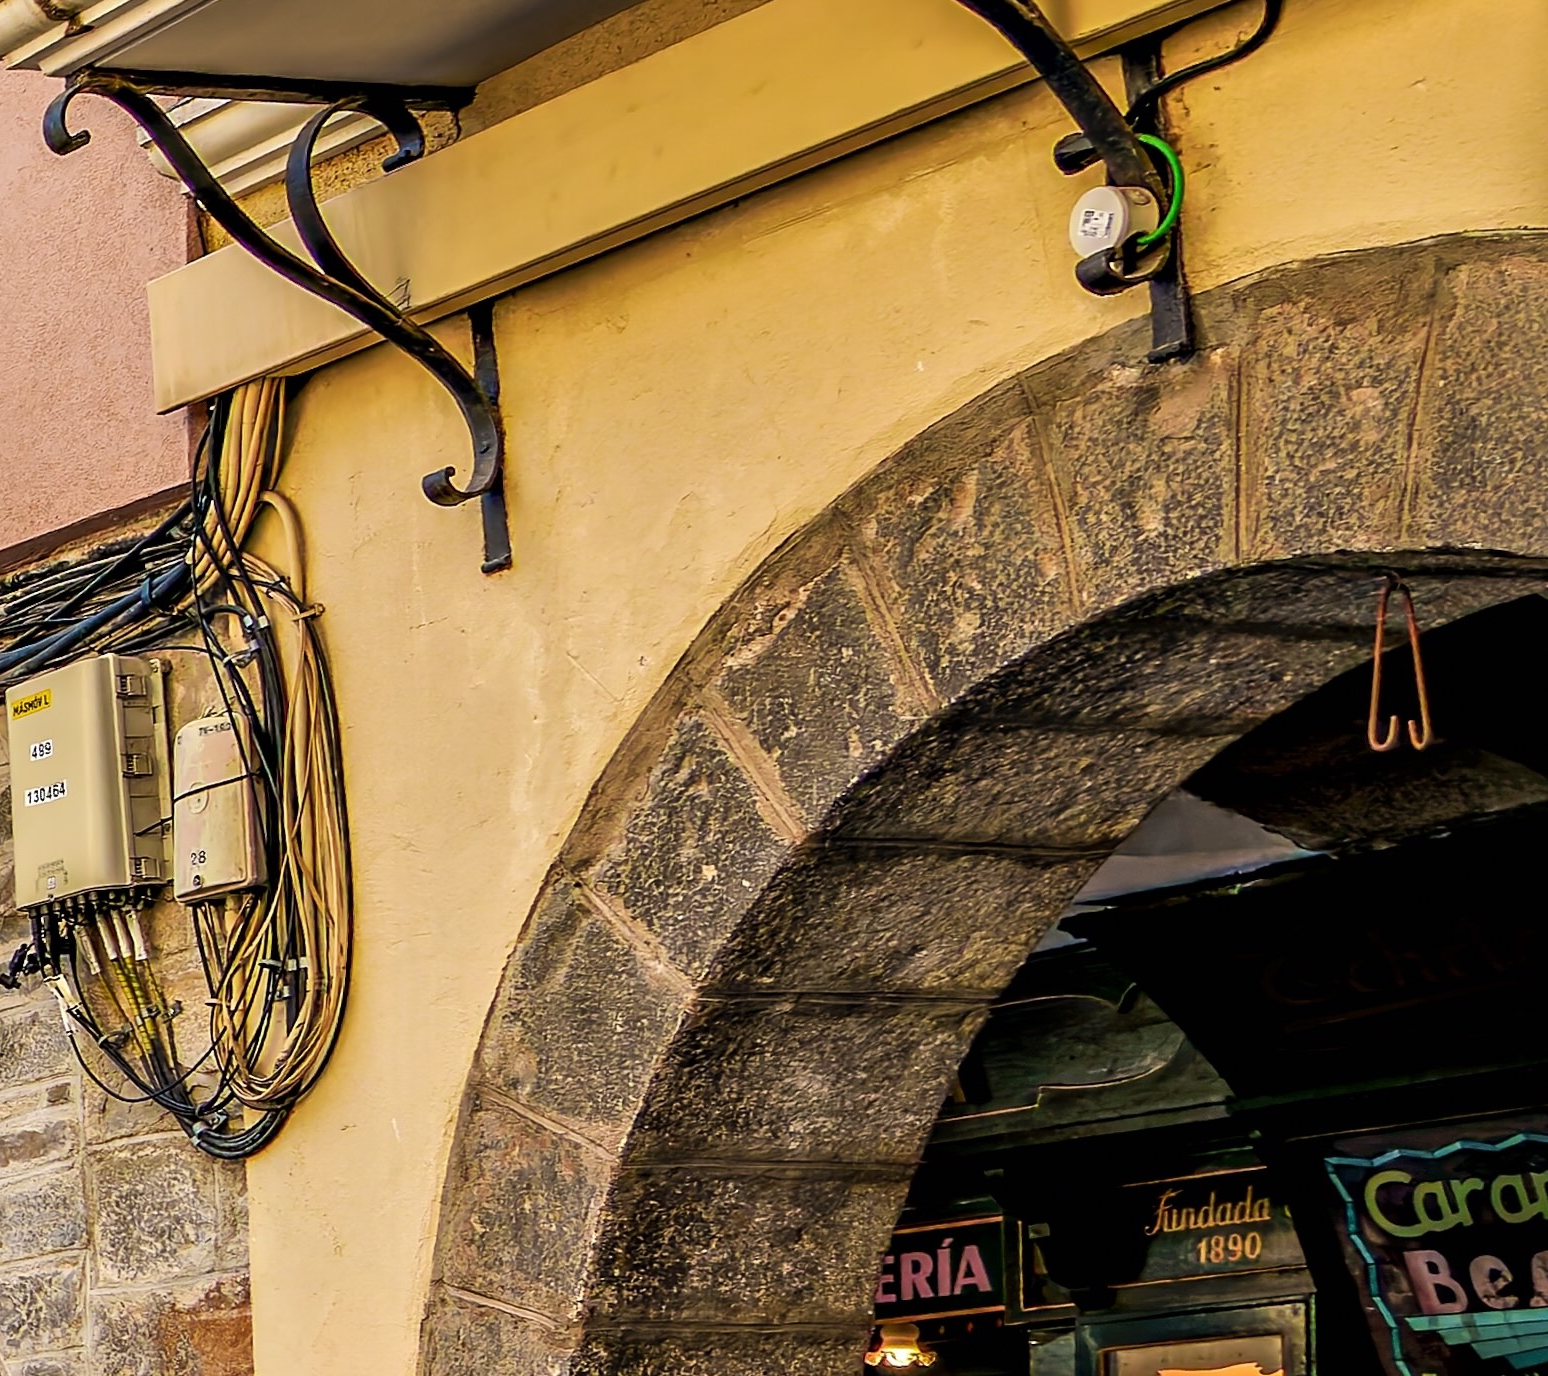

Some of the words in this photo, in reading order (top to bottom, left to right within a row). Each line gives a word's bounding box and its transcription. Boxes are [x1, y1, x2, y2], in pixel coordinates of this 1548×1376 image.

[31, 742, 52, 759] 489
[27, 782, 66, 805] 130464
[190, 850, 207, 866] 28
[1145, 1185, 1271, 1235] Fundada
[1196, 1232, 1262, 1264] 1890
